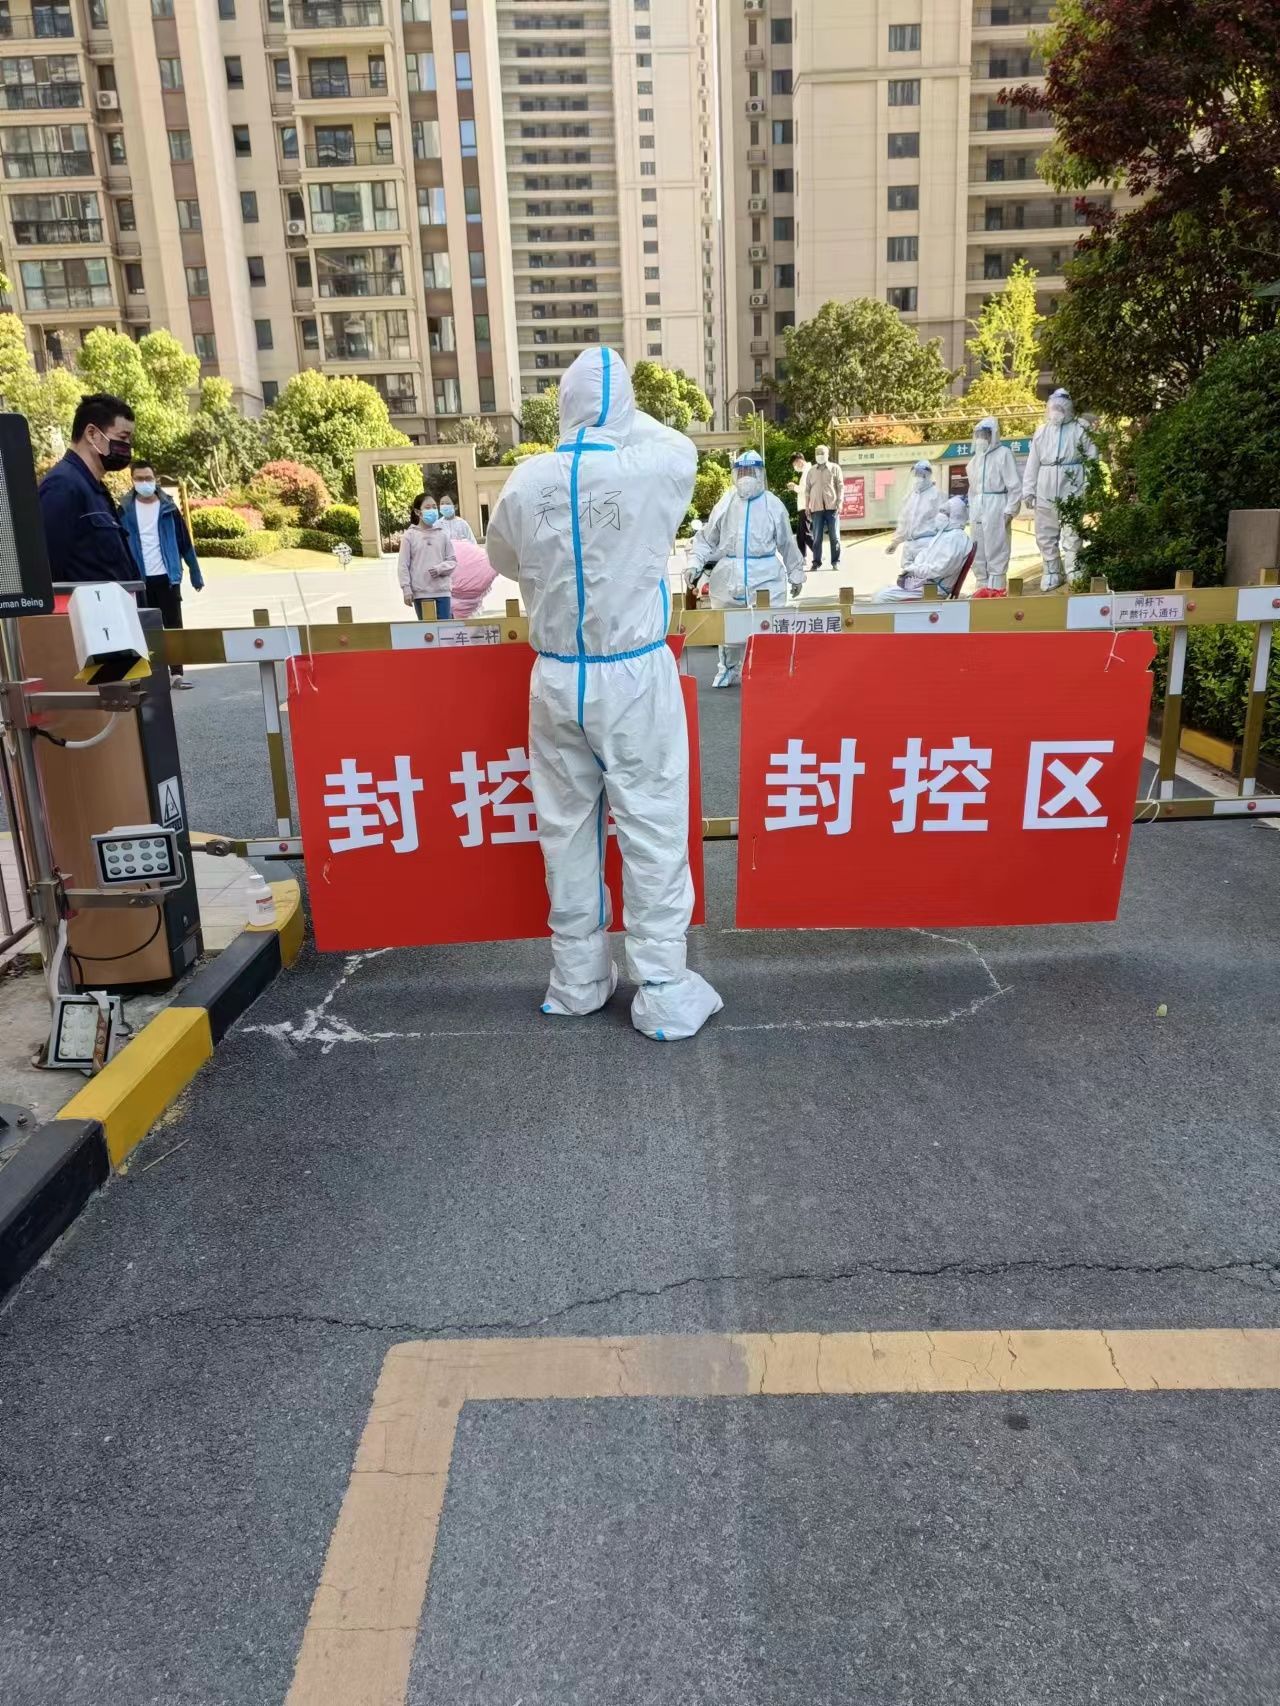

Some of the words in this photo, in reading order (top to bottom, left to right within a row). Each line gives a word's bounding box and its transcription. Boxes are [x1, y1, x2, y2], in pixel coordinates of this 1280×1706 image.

[21, 597, 44, 608] Being
[1120, 607, 1179, 620] 严禁行人通行
[773, 616, 842, 634] 请勿追尾
[440, 629, 499, 646] 一车一杆
[764, 736, 1115, 836] 封控区
[323, 747, 617, 854] 封控
